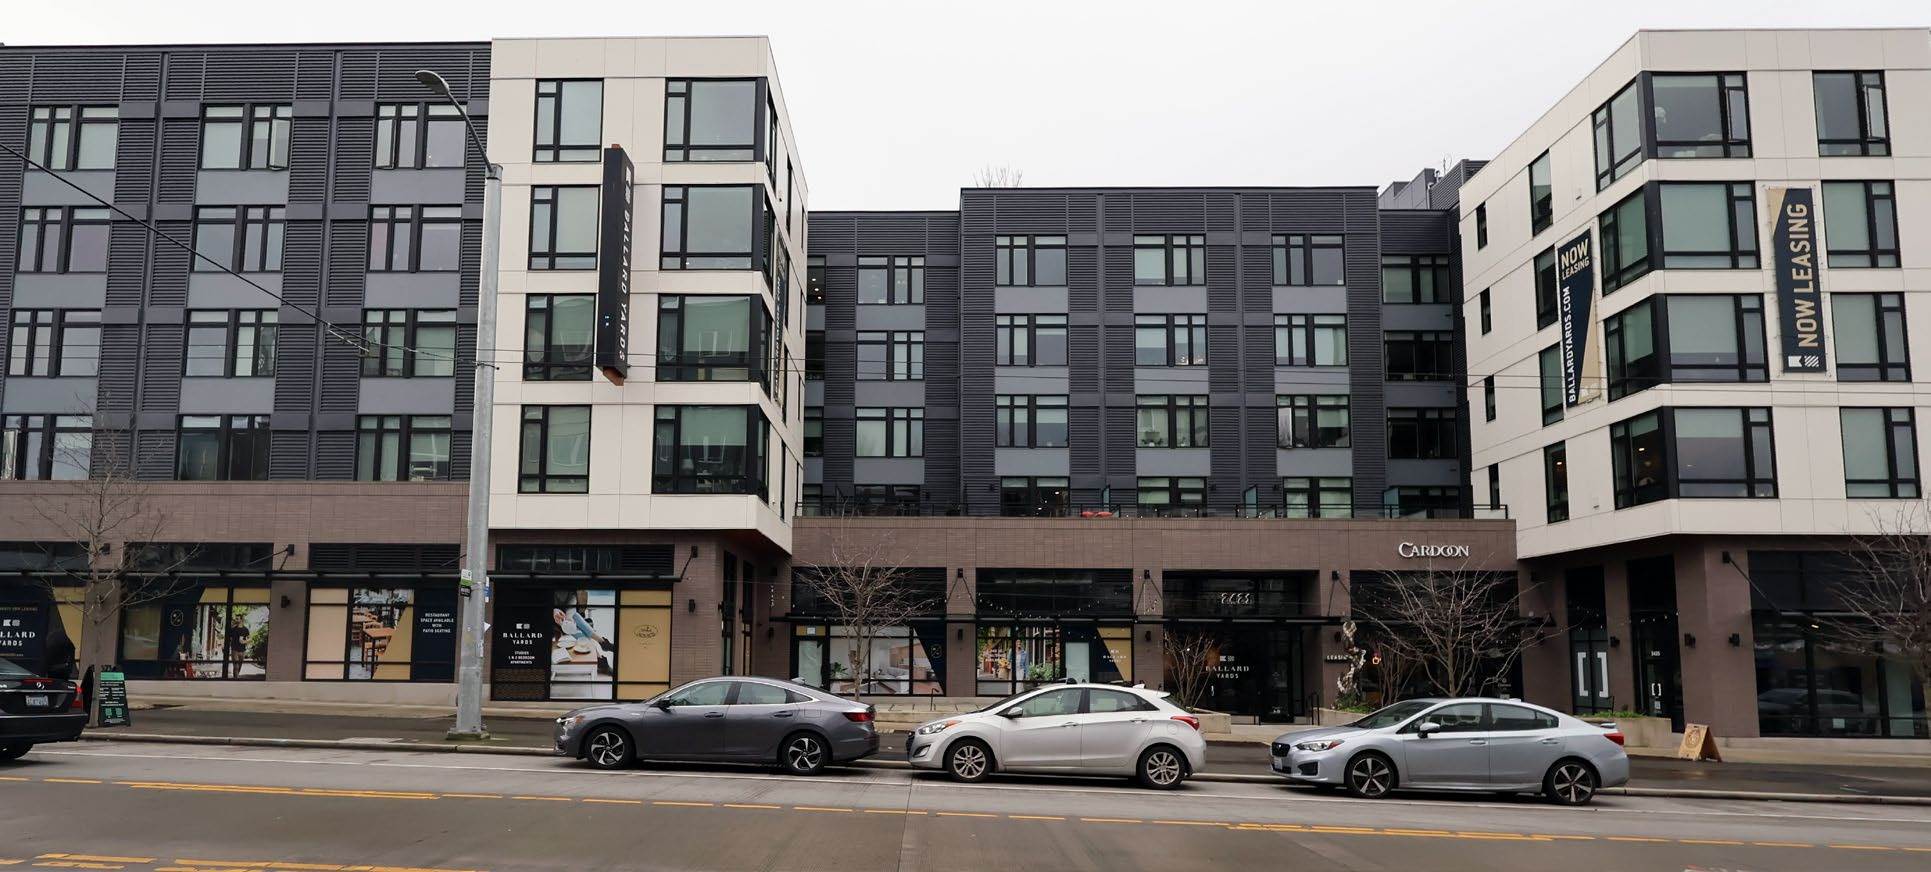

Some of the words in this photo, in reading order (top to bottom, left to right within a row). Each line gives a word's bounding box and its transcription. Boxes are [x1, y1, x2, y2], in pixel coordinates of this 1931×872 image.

[621, 209, 630, 295] BALLARD
[1561, 239, 1589, 270] NOW
[1562, 256, 1590, 280] LEASING
[1787, 203, 1814, 293] LEASING
[619, 303, 627, 360] YARDS
[1562, 286, 1576, 403] BALLARDYARDS.COM
[1794, 299, 1818, 348] NOW
[1398, 542, 1470, 558] CARDOON
